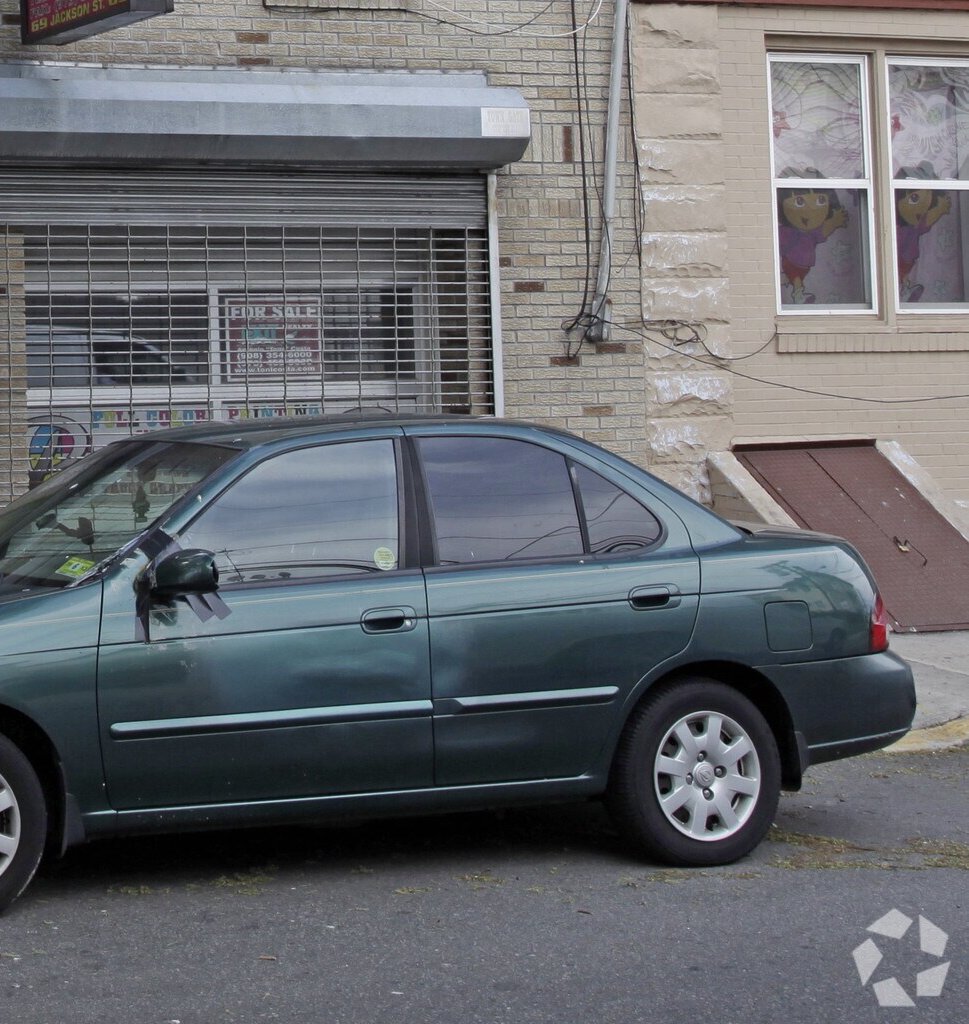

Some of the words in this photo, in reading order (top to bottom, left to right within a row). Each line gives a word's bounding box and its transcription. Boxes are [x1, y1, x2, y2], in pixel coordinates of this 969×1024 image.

[31, 16, 49, 32] 69
[51, 1, 90, 27] JACKSON
[231, 304, 266, 320] FOR
[272, 304, 316, 320] SALE
[146, 408, 209, 427] COLOR
